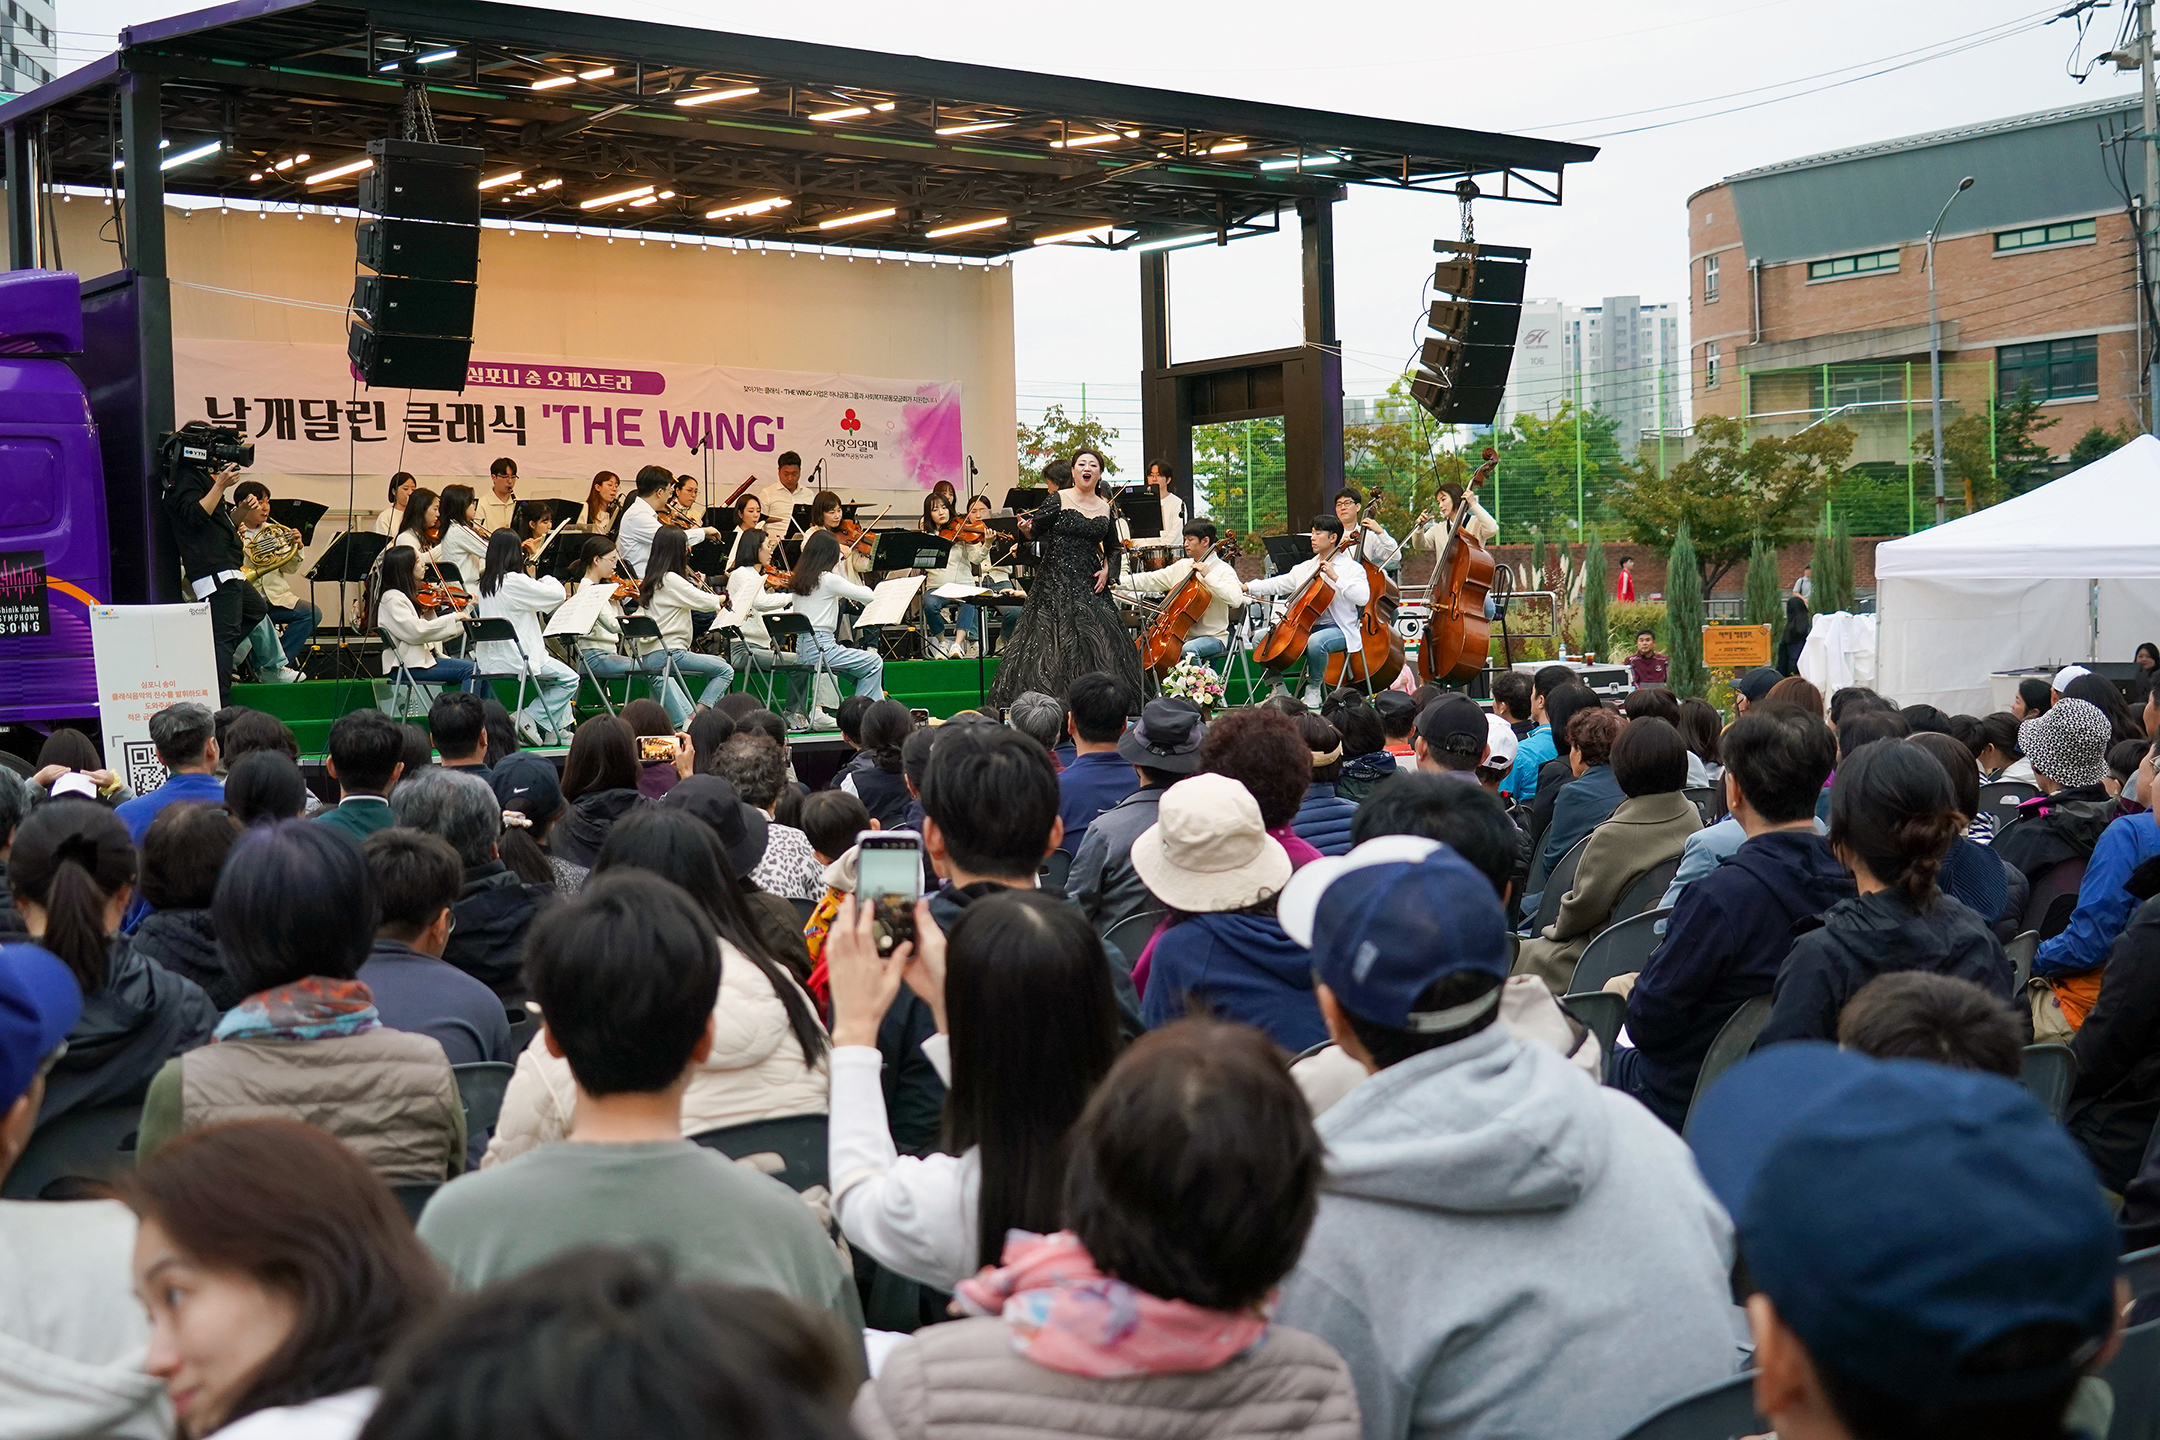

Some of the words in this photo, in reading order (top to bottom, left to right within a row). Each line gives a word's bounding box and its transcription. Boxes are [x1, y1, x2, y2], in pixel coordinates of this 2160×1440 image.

[1531, 357, 1545, 365] 106
[467, 367, 520, 385] 심포니
[525, 370, 542, 386] 송
[547, 371, 633, 391] 오케스트라
[764, 387, 781, 395] 클래식
[205, 397, 388, 442] 날개달린
[403, 402, 527, 446] 클래식
[825, 438, 878, 452] 사랑의열매
[0, 605, 19, 614] hinik
[21, 604, 39, 613] Hahm
[141, 681, 161, 690] 심포니
[162, 680, 176, 688] 송이
[127, 713, 141, 721] 적은
